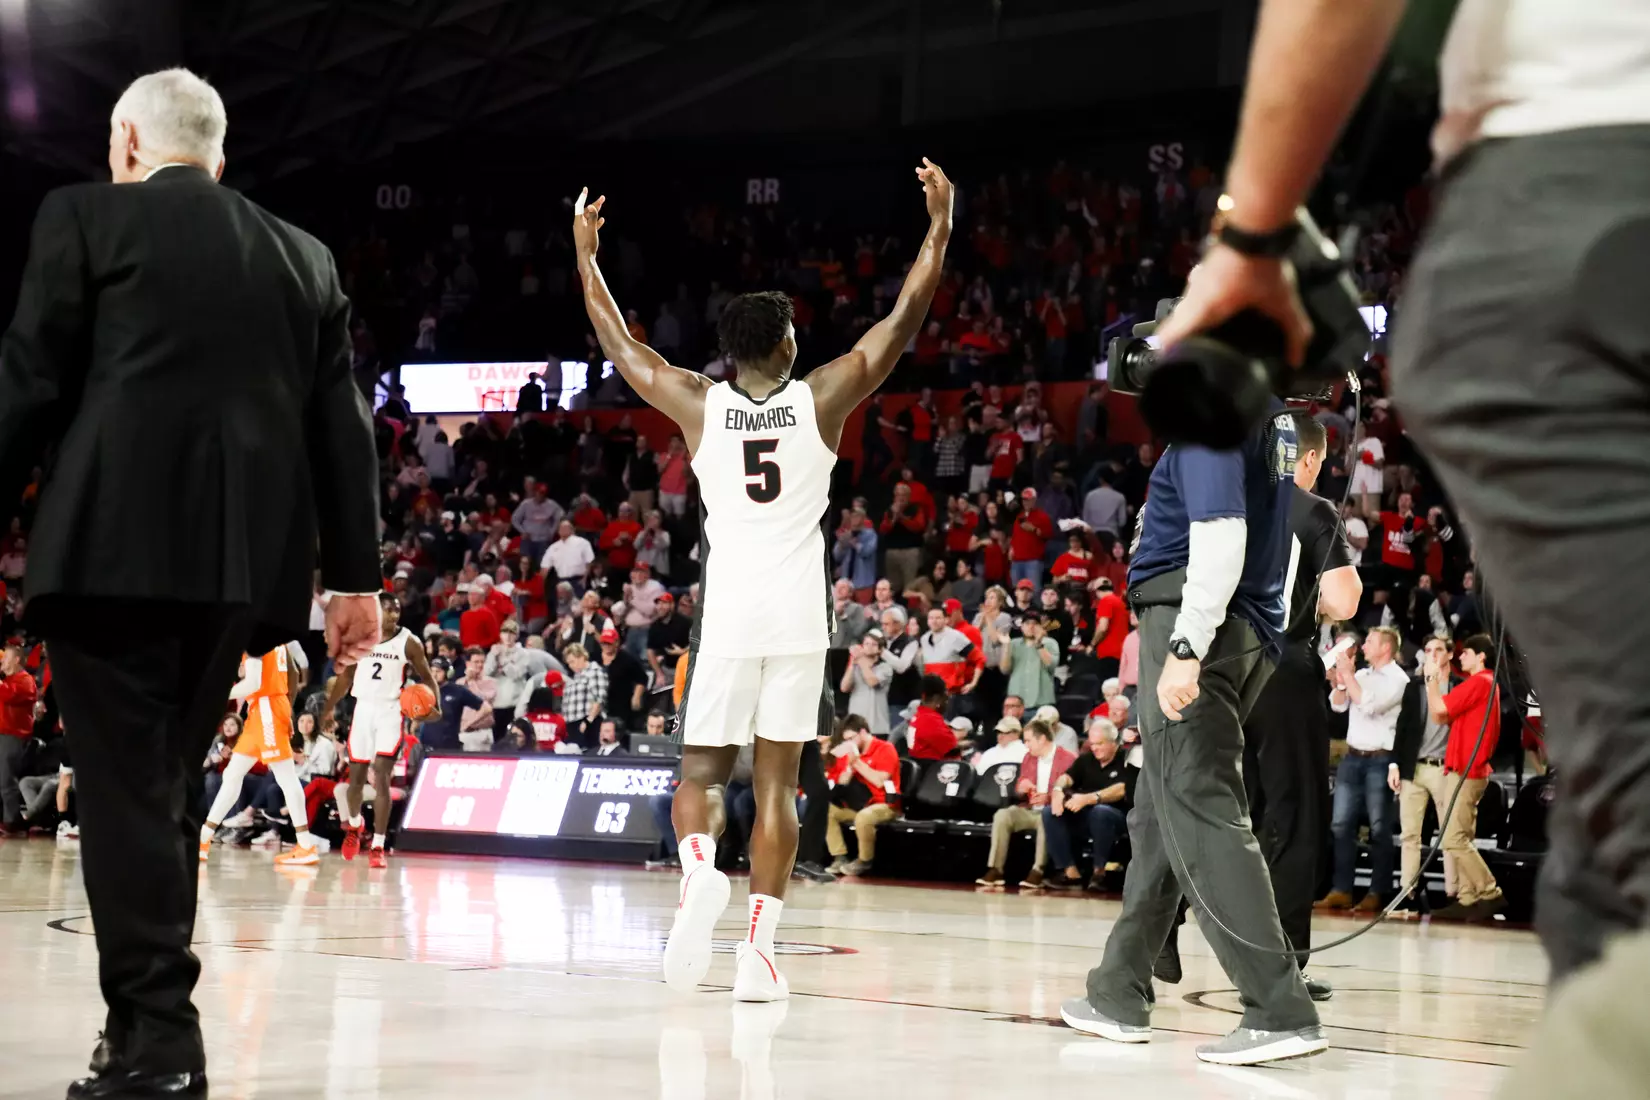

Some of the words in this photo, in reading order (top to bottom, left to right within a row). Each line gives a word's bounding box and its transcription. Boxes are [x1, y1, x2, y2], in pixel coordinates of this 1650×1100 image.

[746, 178, 780, 204] RR
[468, 364, 548, 380] DAWG
[725, 406, 797, 431] EDWARDS
[742, 438, 782, 503] 5
[371, 662, 382, 680] 2
[578, 767, 673, 796] TENNESSEE
[594, 801, 630, 833] 63
